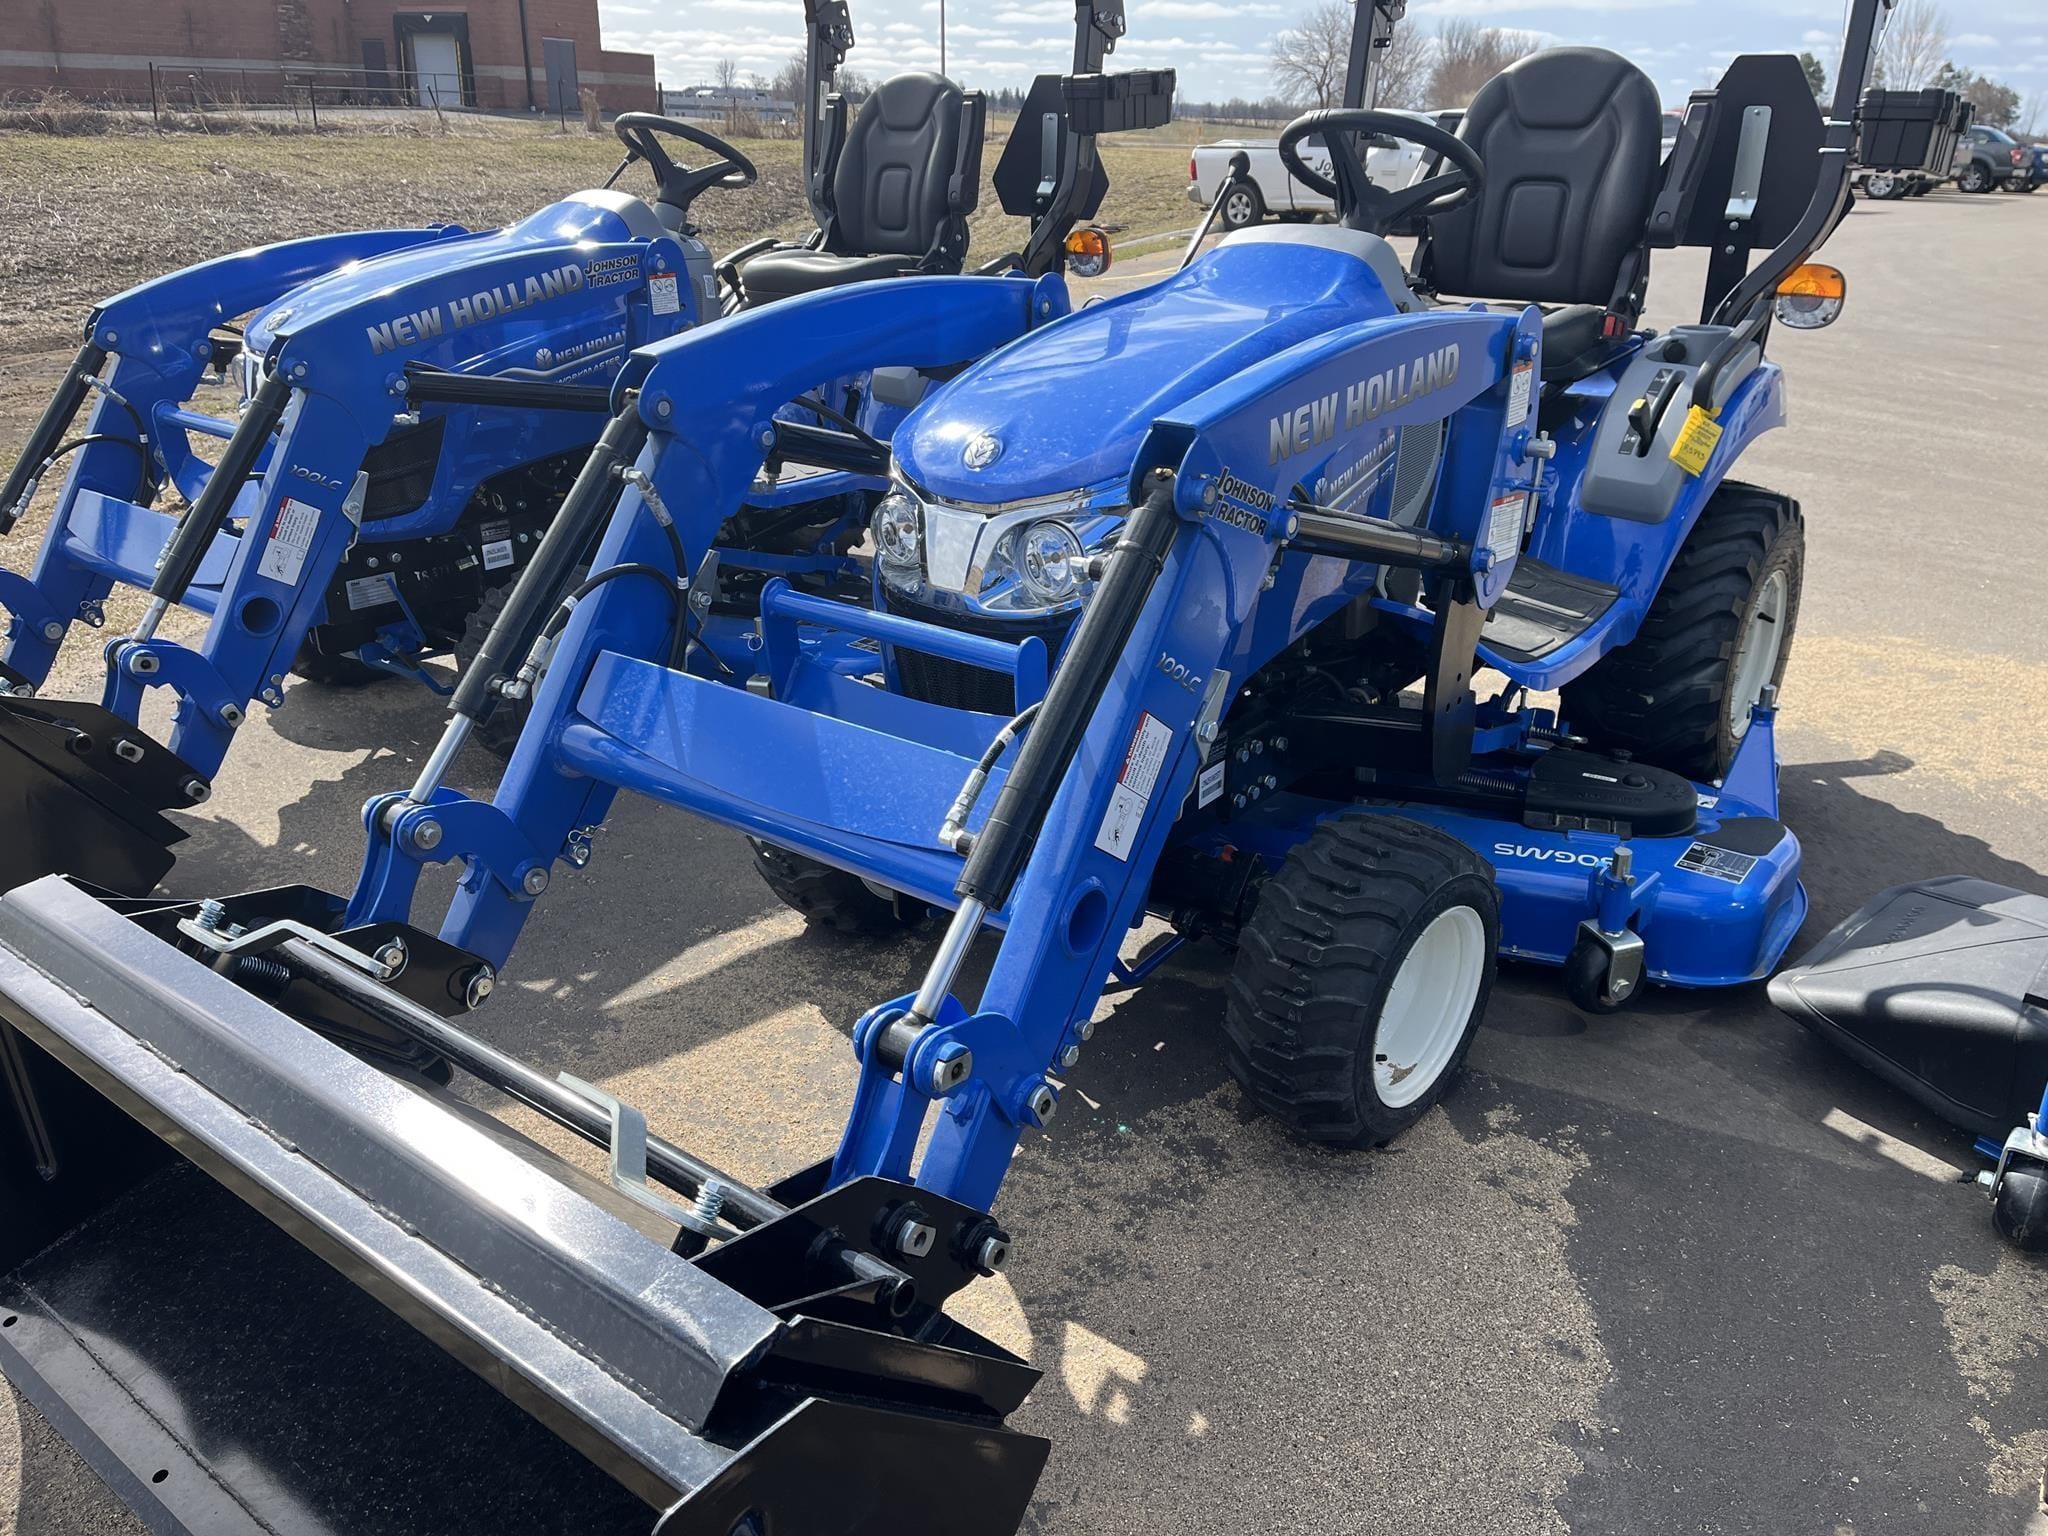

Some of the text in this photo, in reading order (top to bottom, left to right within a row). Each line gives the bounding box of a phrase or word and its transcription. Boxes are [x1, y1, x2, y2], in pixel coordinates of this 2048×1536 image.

[584, 254, 638, 275] JOHNSON
[587, 268, 640, 289] TRACTOR
[366, 263, 583, 356] NEW HOLLAND
[555, 344, 584, 364] NEW
[1269, 343, 1460, 465] NEW HOLLAND
[289, 464, 343, 490] 100LC
[1330, 431, 1395, 497] NEW HOLLAND
[1214, 466, 1276, 512] JOHNSON
[1157, 651, 1203, 693] 100LC
